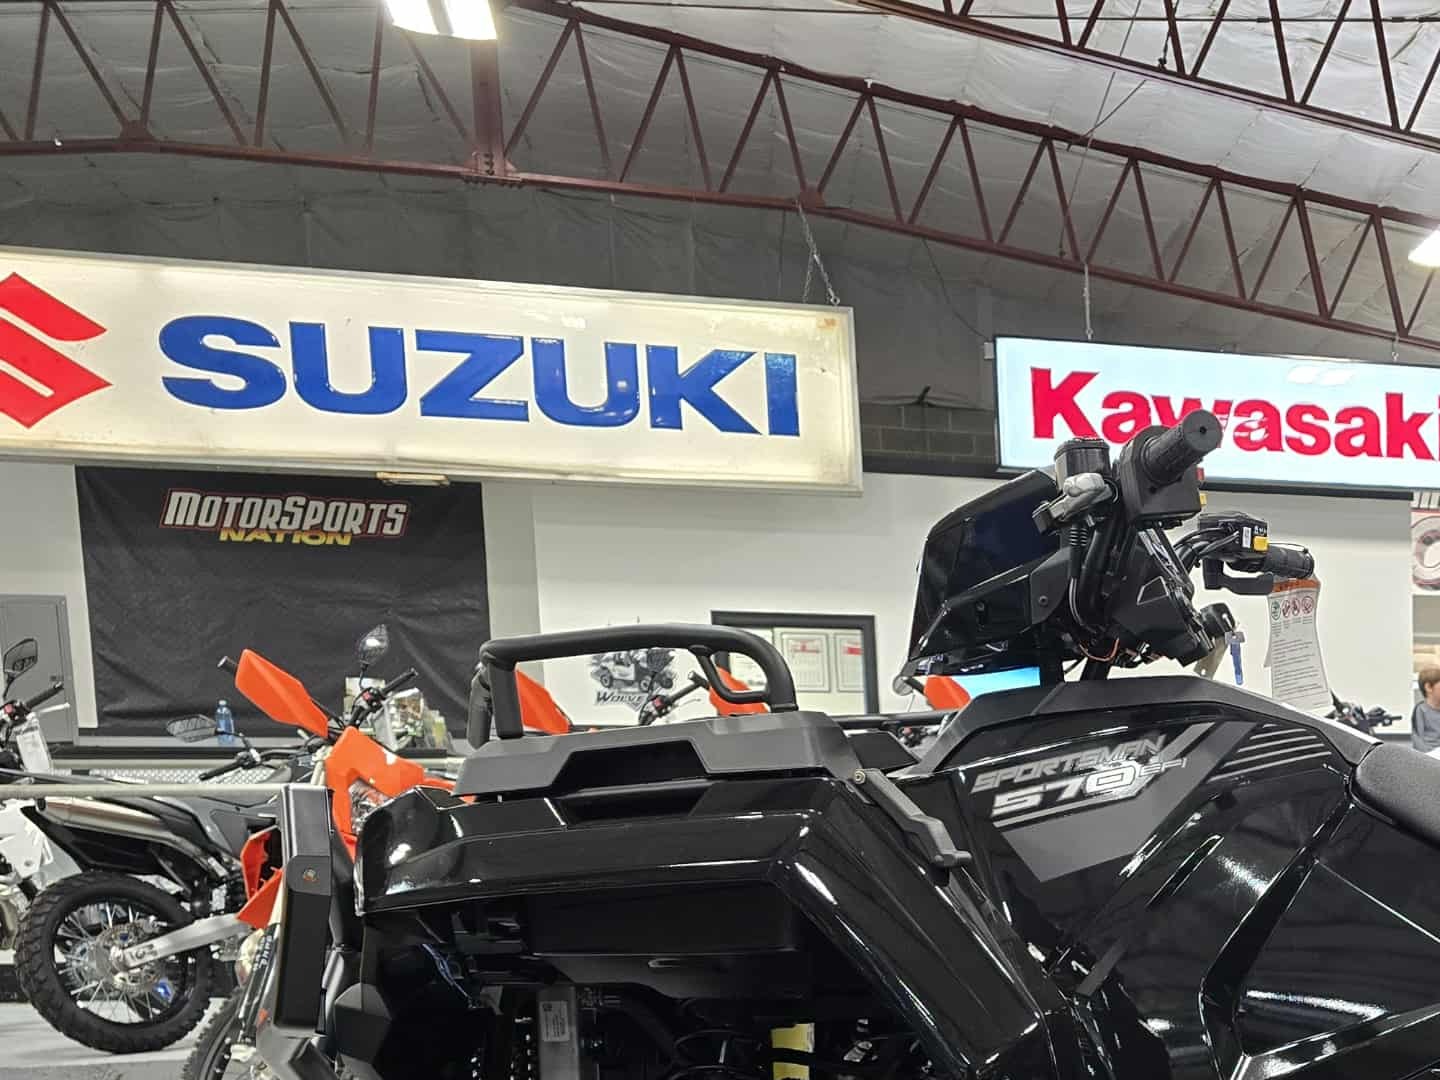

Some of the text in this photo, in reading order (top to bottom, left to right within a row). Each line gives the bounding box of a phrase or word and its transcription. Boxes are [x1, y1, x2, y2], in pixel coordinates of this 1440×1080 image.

[159, 315, 800, 437] SUZUKI
[218, 527, 352, 546] NATION
[970, 735, 1167, 793] SPORTSMAN
[991, 761, 1139, 816] 570
